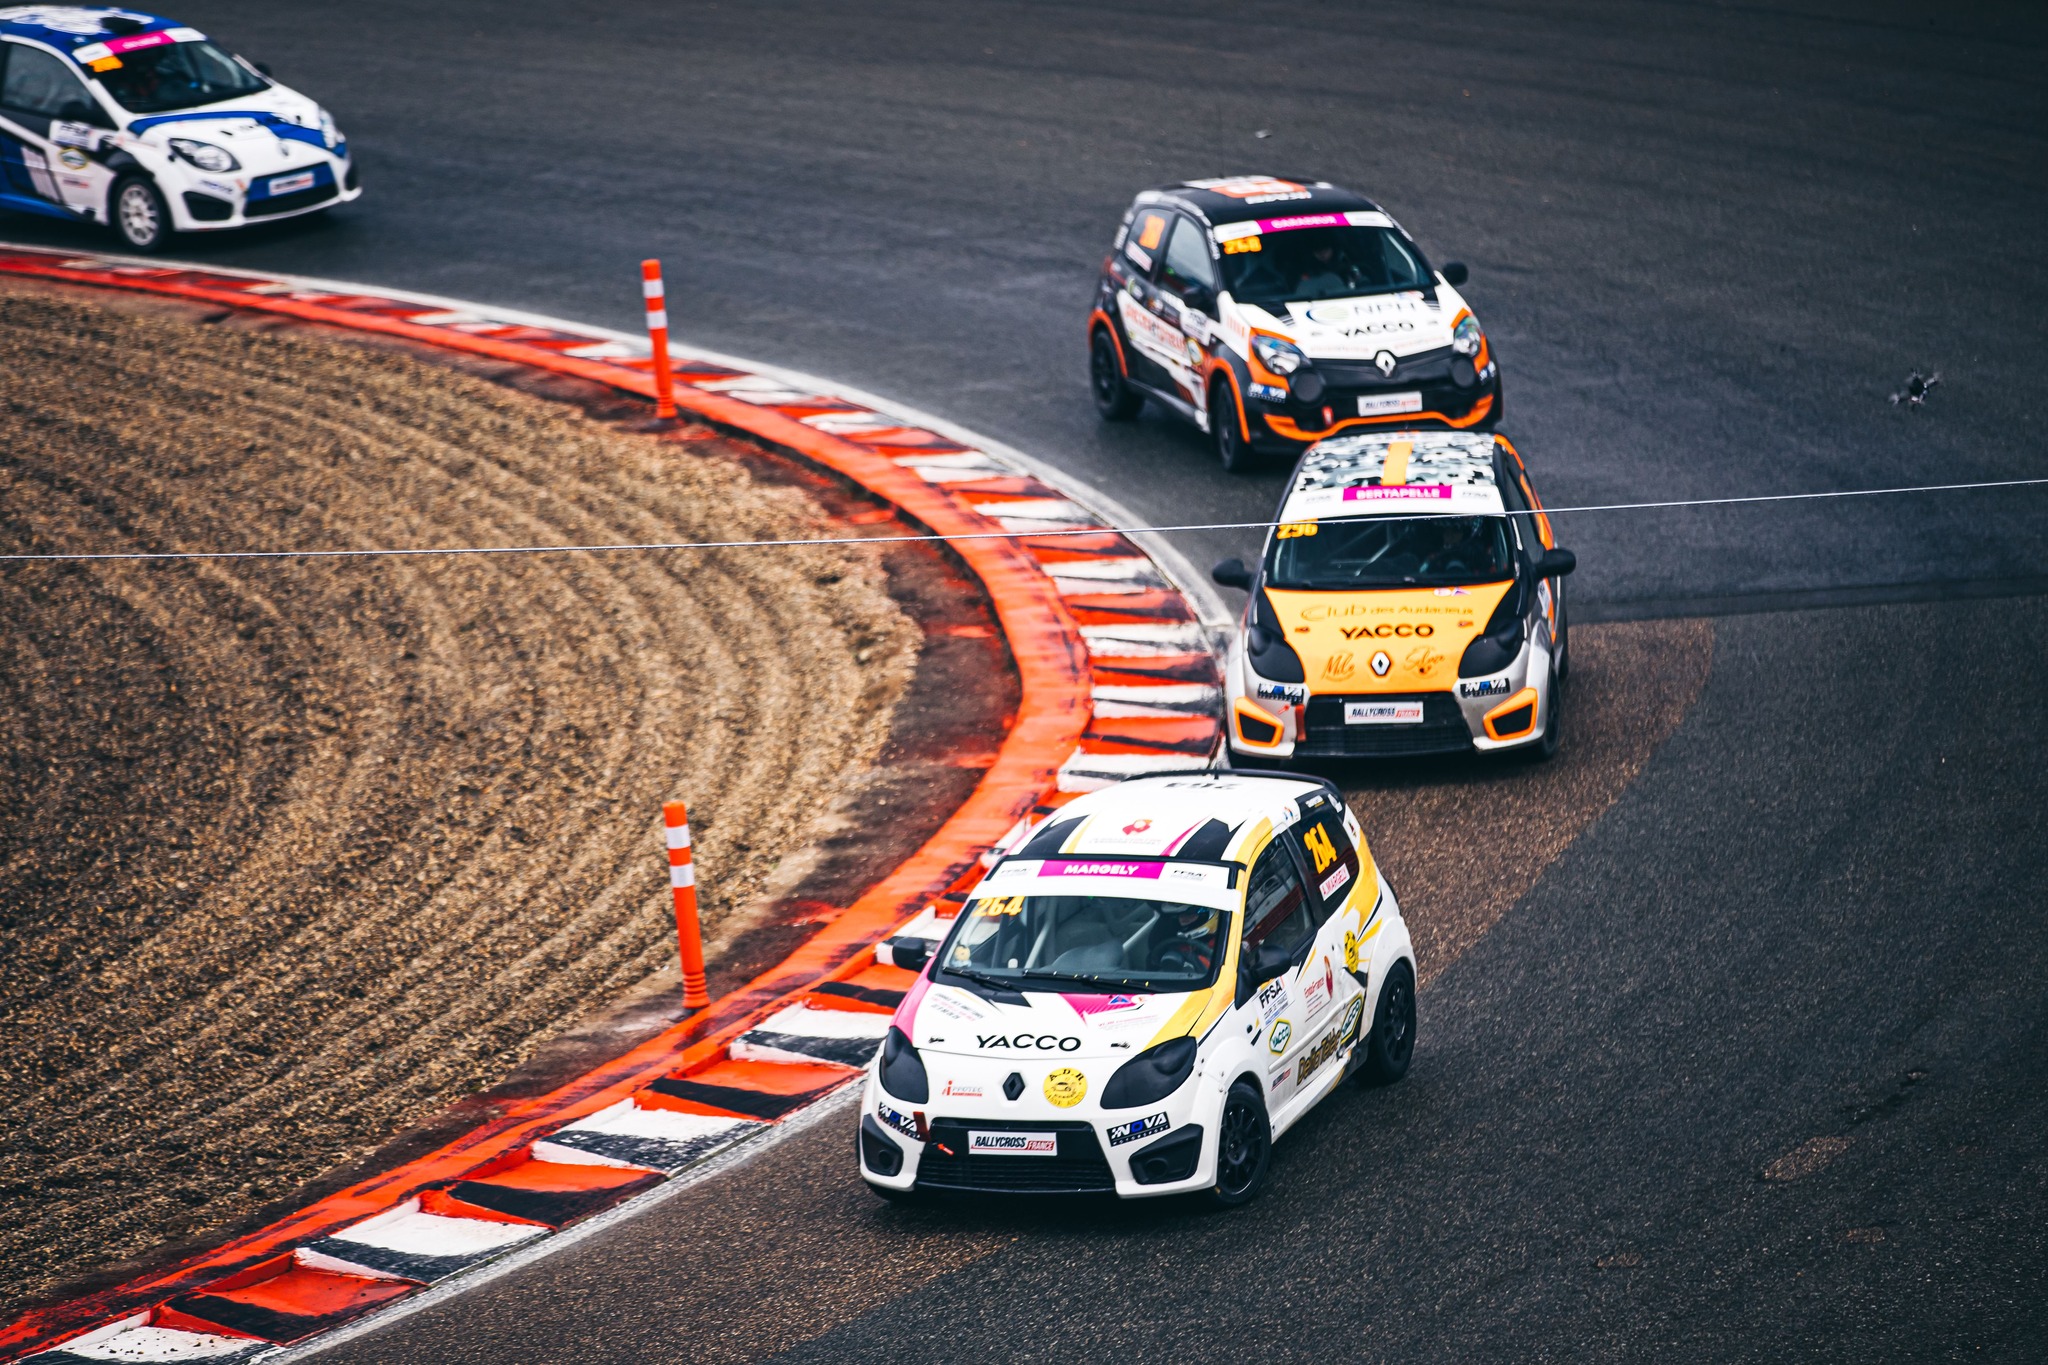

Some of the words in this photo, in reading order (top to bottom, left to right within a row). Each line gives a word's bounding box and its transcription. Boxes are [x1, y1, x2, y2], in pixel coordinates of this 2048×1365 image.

[1338, 322, 1414, 337] YACCO
[1356, 488, 1440, 499] BERTAPELLE
[1340, 623, 1434, 640] YACCO
[1352, 707, 1396, 717] RALLYCROSS
[1303, 821, 1338, 874] 264
[1063, 864, 1139, 876] MARGELY
[974, 896, 1025, 917] 264
[1258, 979, 1284, 1009] FFSA
[976, 1034, 1081, 1052] YACCO
[1271, 1026, 1290, 1048] YACCO
[974, 1136, 1027, 1148] RALLYCROSS
[1027, 1140, 1055, 1151] FRANCE
